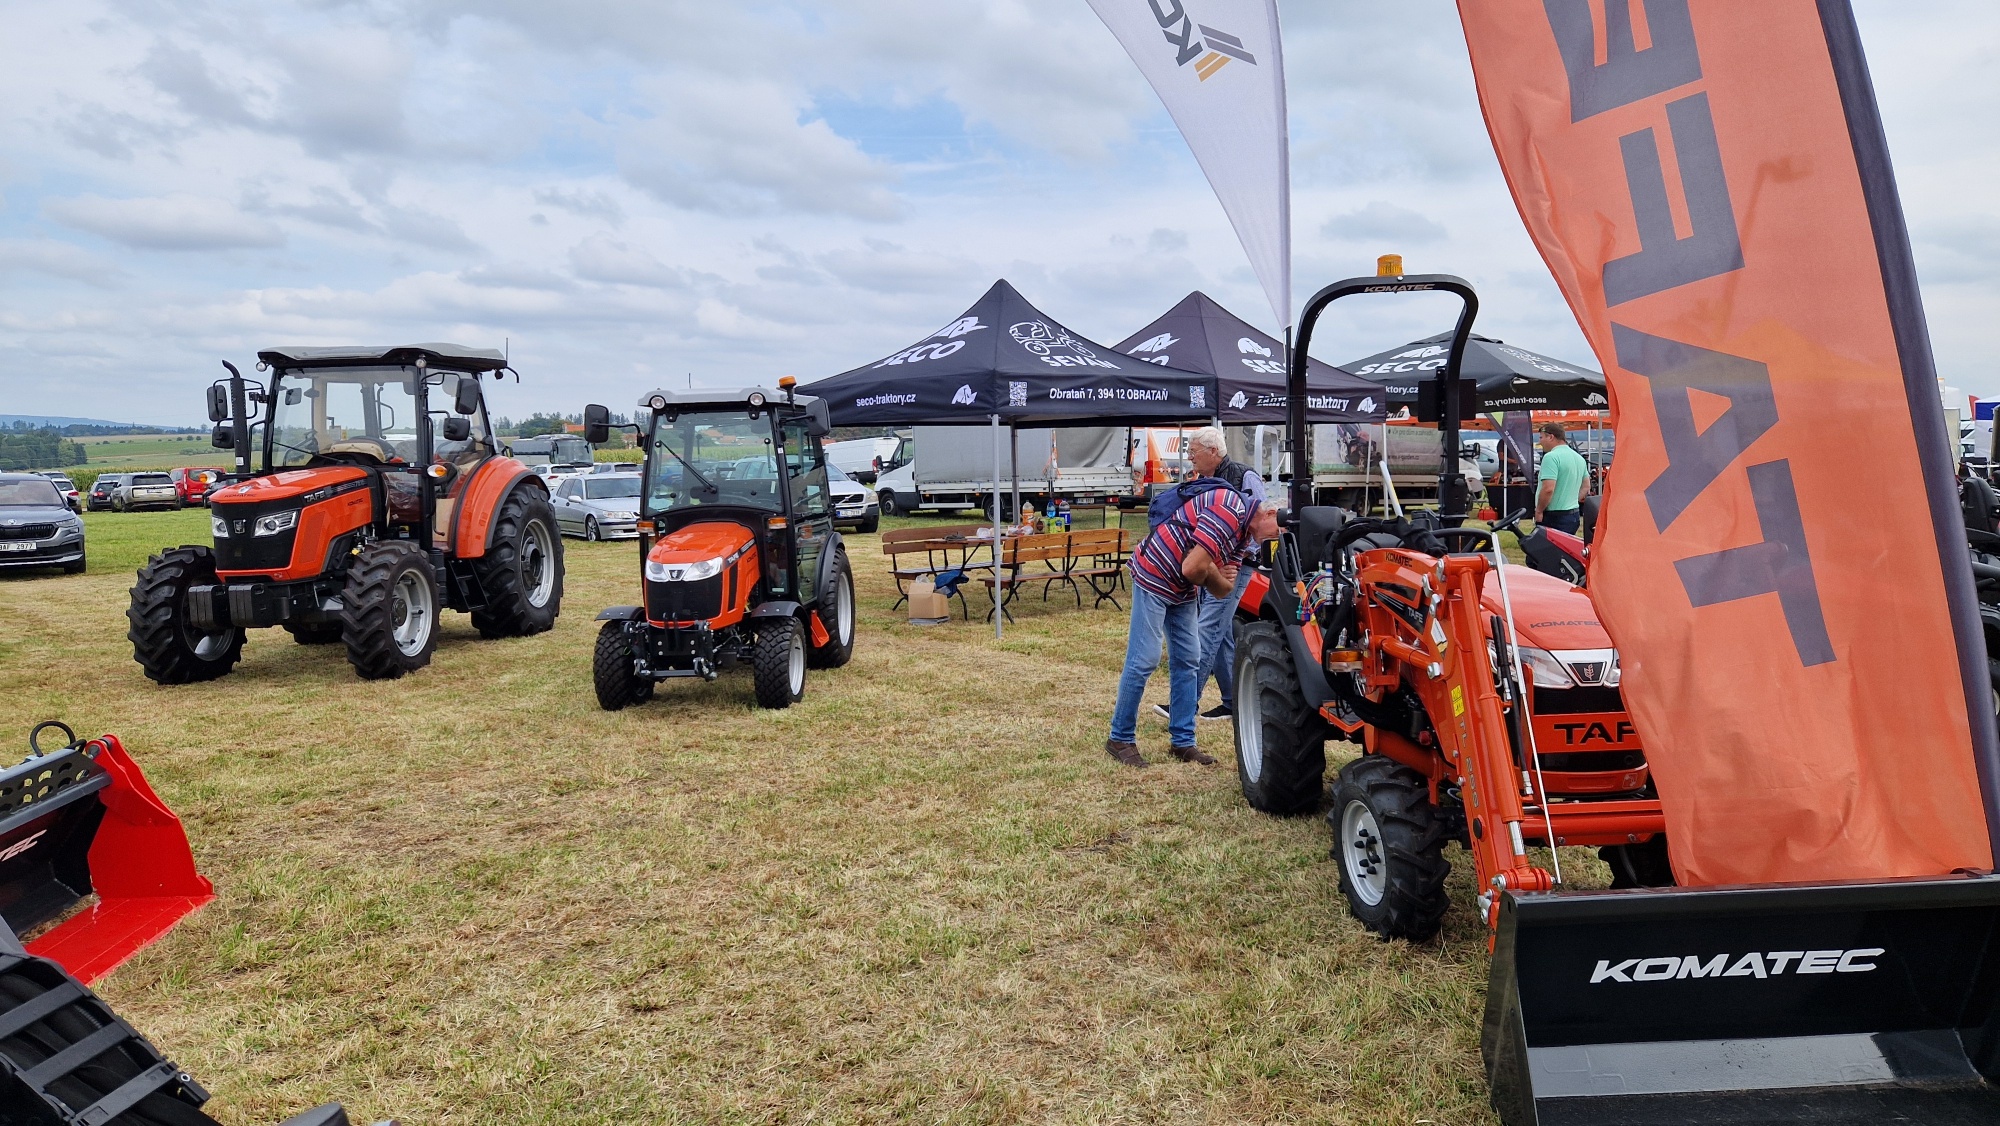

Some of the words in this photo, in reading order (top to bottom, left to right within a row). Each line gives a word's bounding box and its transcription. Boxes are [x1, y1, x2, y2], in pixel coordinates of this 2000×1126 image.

[1364, 283, 1435, 293] KOMATEC
[872, 340, 966, 369] SECO
[1241, 358, 1308, 377] SEC
[1355, 358, 1448, 375] SECO
[856, 393, 916, 407] seco-traktory.cz
[1049, 387, 1085, 399] Obrataň
[1087, 388, 1096, 401] 7,
[1098, 388, 1114, 399] 394
[1116, 388, 1125, 399] 12
[1126, 387, 1169, 401] OBRATAŇ
[1307, 395, 1349, 412] traktory
[304, 490, 326, 503] TAFE
[1407, 606, 1424, 624] TAFE
[1589, 947, 1886, 984] KOMATEC
